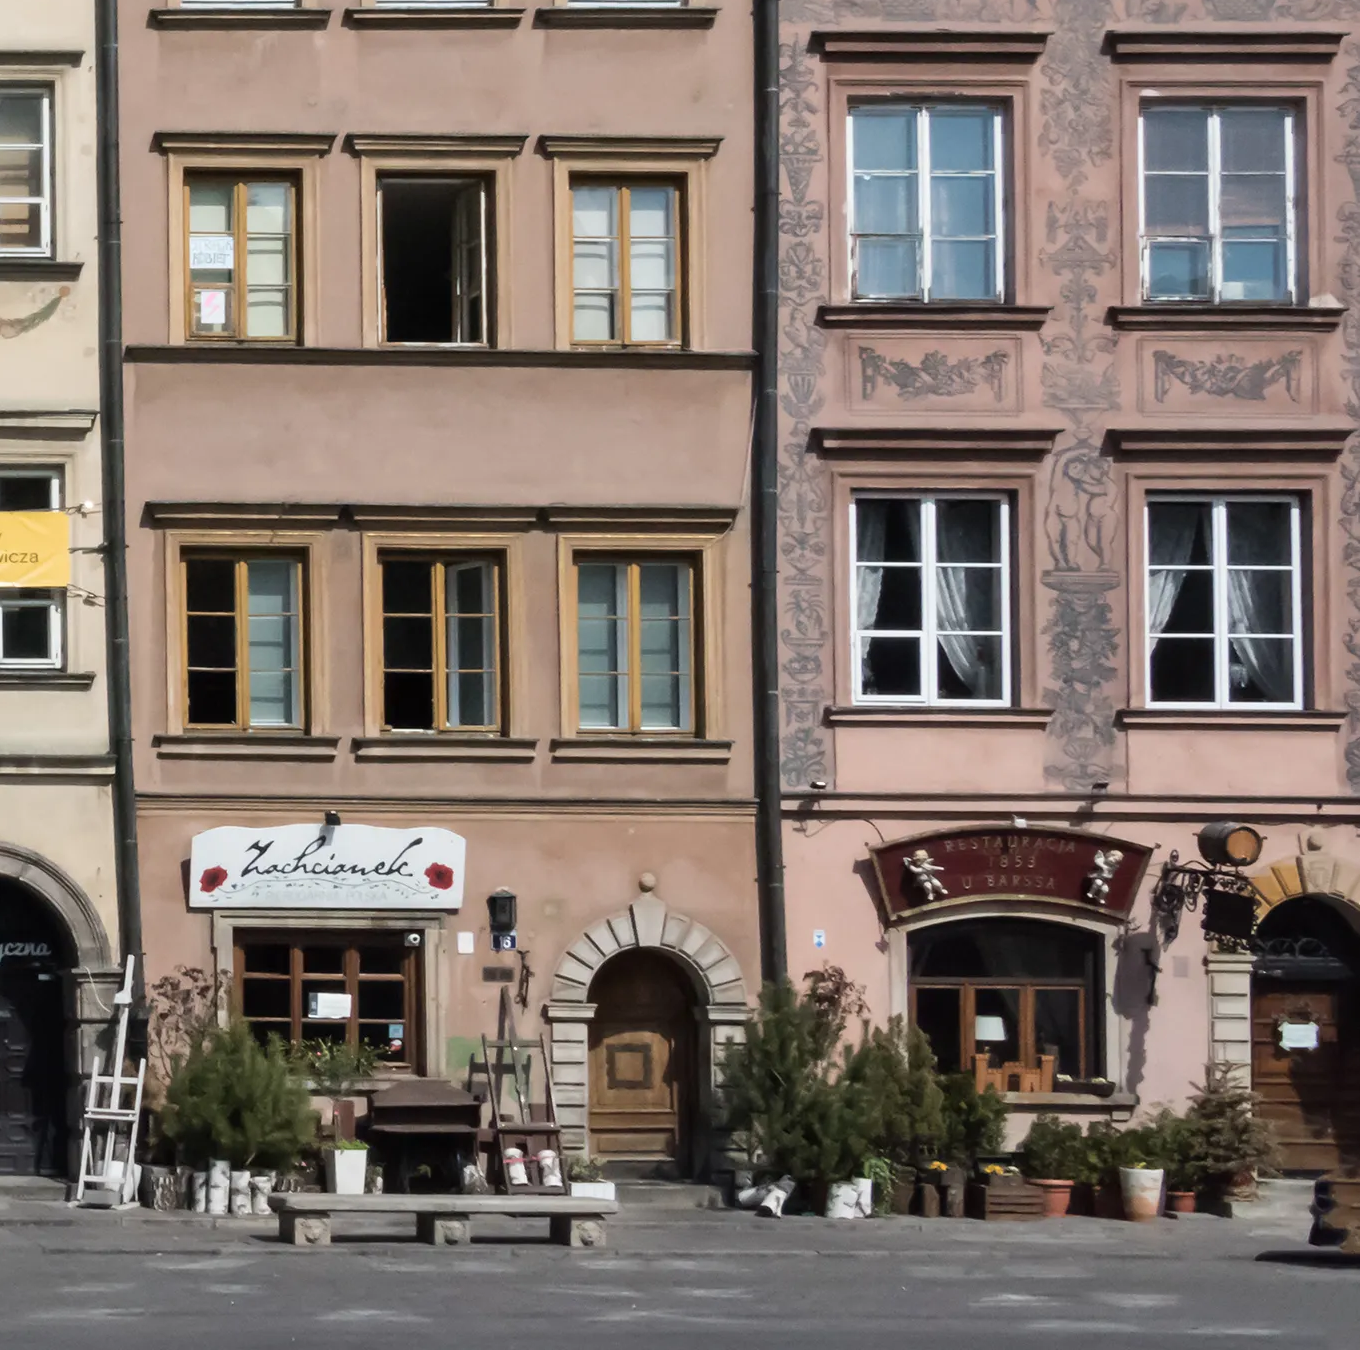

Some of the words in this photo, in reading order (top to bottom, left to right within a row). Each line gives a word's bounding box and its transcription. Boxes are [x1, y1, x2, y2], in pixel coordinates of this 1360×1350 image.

[944, 836, 1076, 852] RESTAURACJA
[240, 835, 423, 877] Zachcianek
[961, 876, 972, 889] U
[985, 874, 1055, 890] BARSSA
